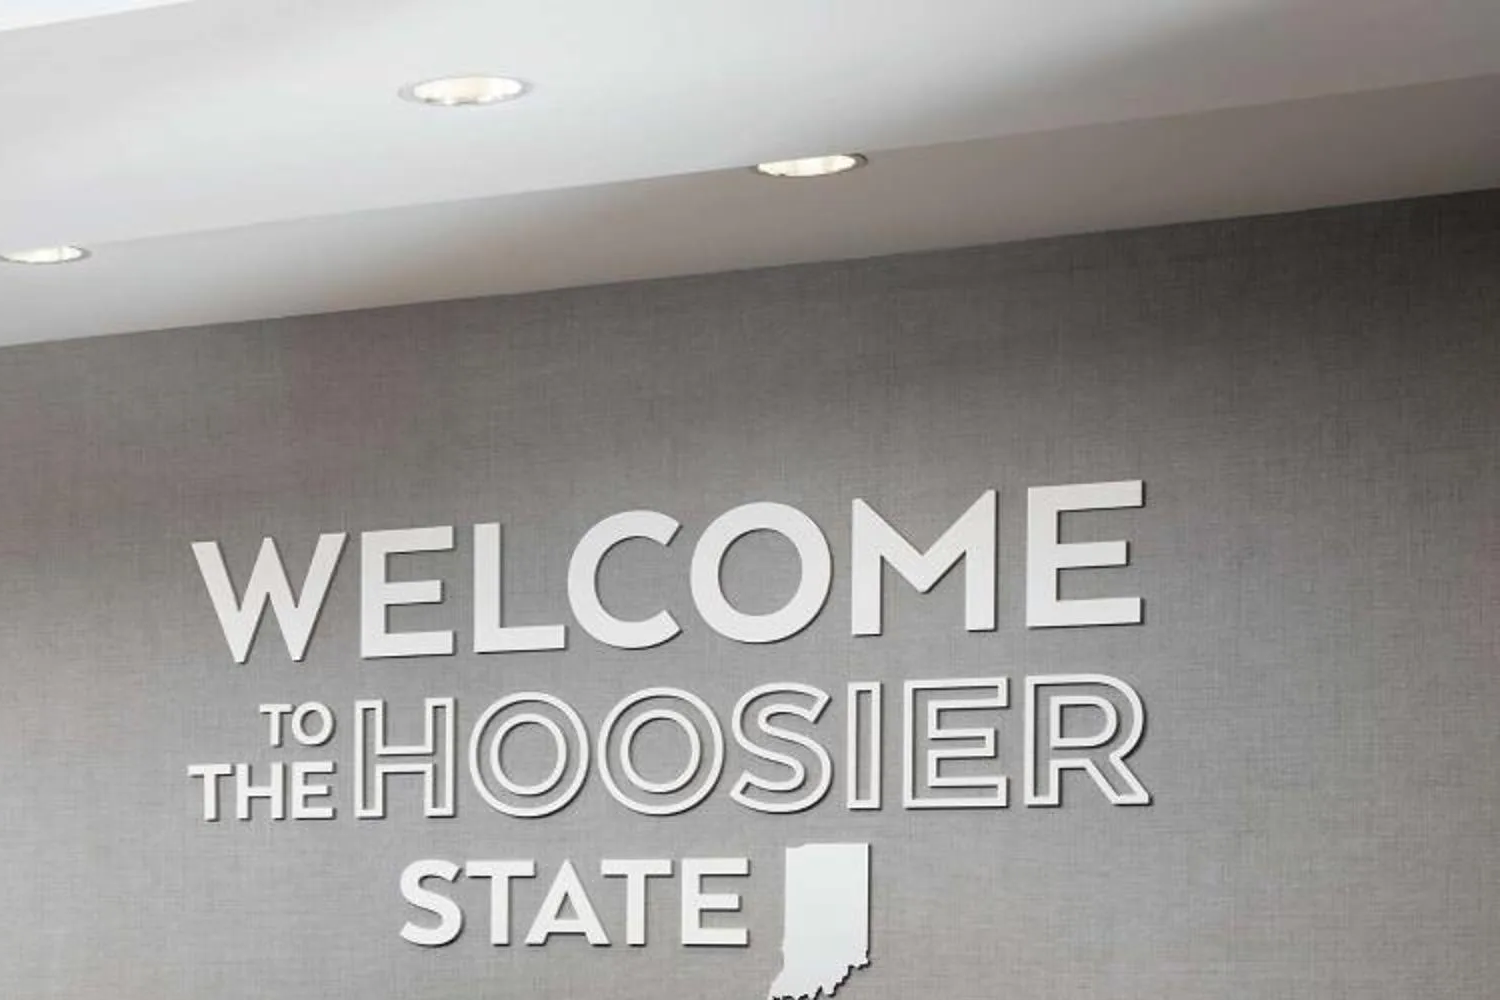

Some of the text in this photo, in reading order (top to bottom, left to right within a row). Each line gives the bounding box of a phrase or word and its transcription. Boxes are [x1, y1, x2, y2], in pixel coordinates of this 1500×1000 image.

[191, 480, 1145, 663] WELCOME
[186, 673, 1152, 821] THE HOOSIER
[258, 700, 334, 747] TO
[399, 856, 749, 947] STATE
